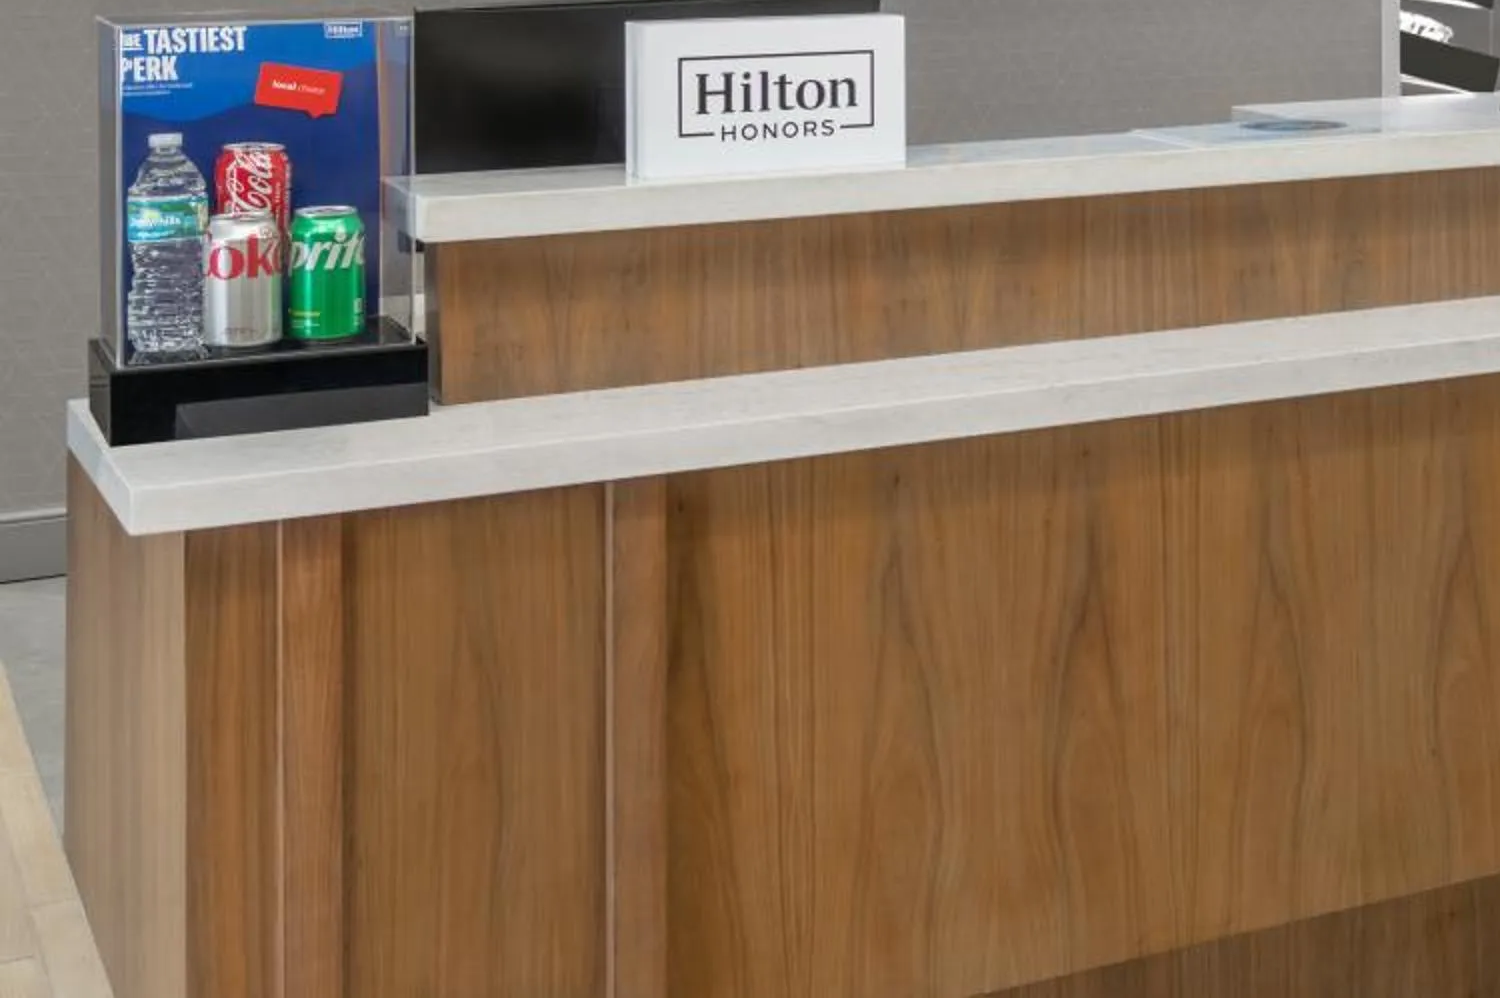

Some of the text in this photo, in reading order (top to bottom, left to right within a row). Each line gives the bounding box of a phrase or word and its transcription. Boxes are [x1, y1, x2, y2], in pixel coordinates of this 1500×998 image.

[144, 26, 247, 54] TASTIEST
[121, 55, 178, 82] PERK
[695, 70, 858, 115] Hilton
[720, 119, 835, 141] HONORS
[203, 232, 283, 280] ok
[290, 225, 366, 276] prit
